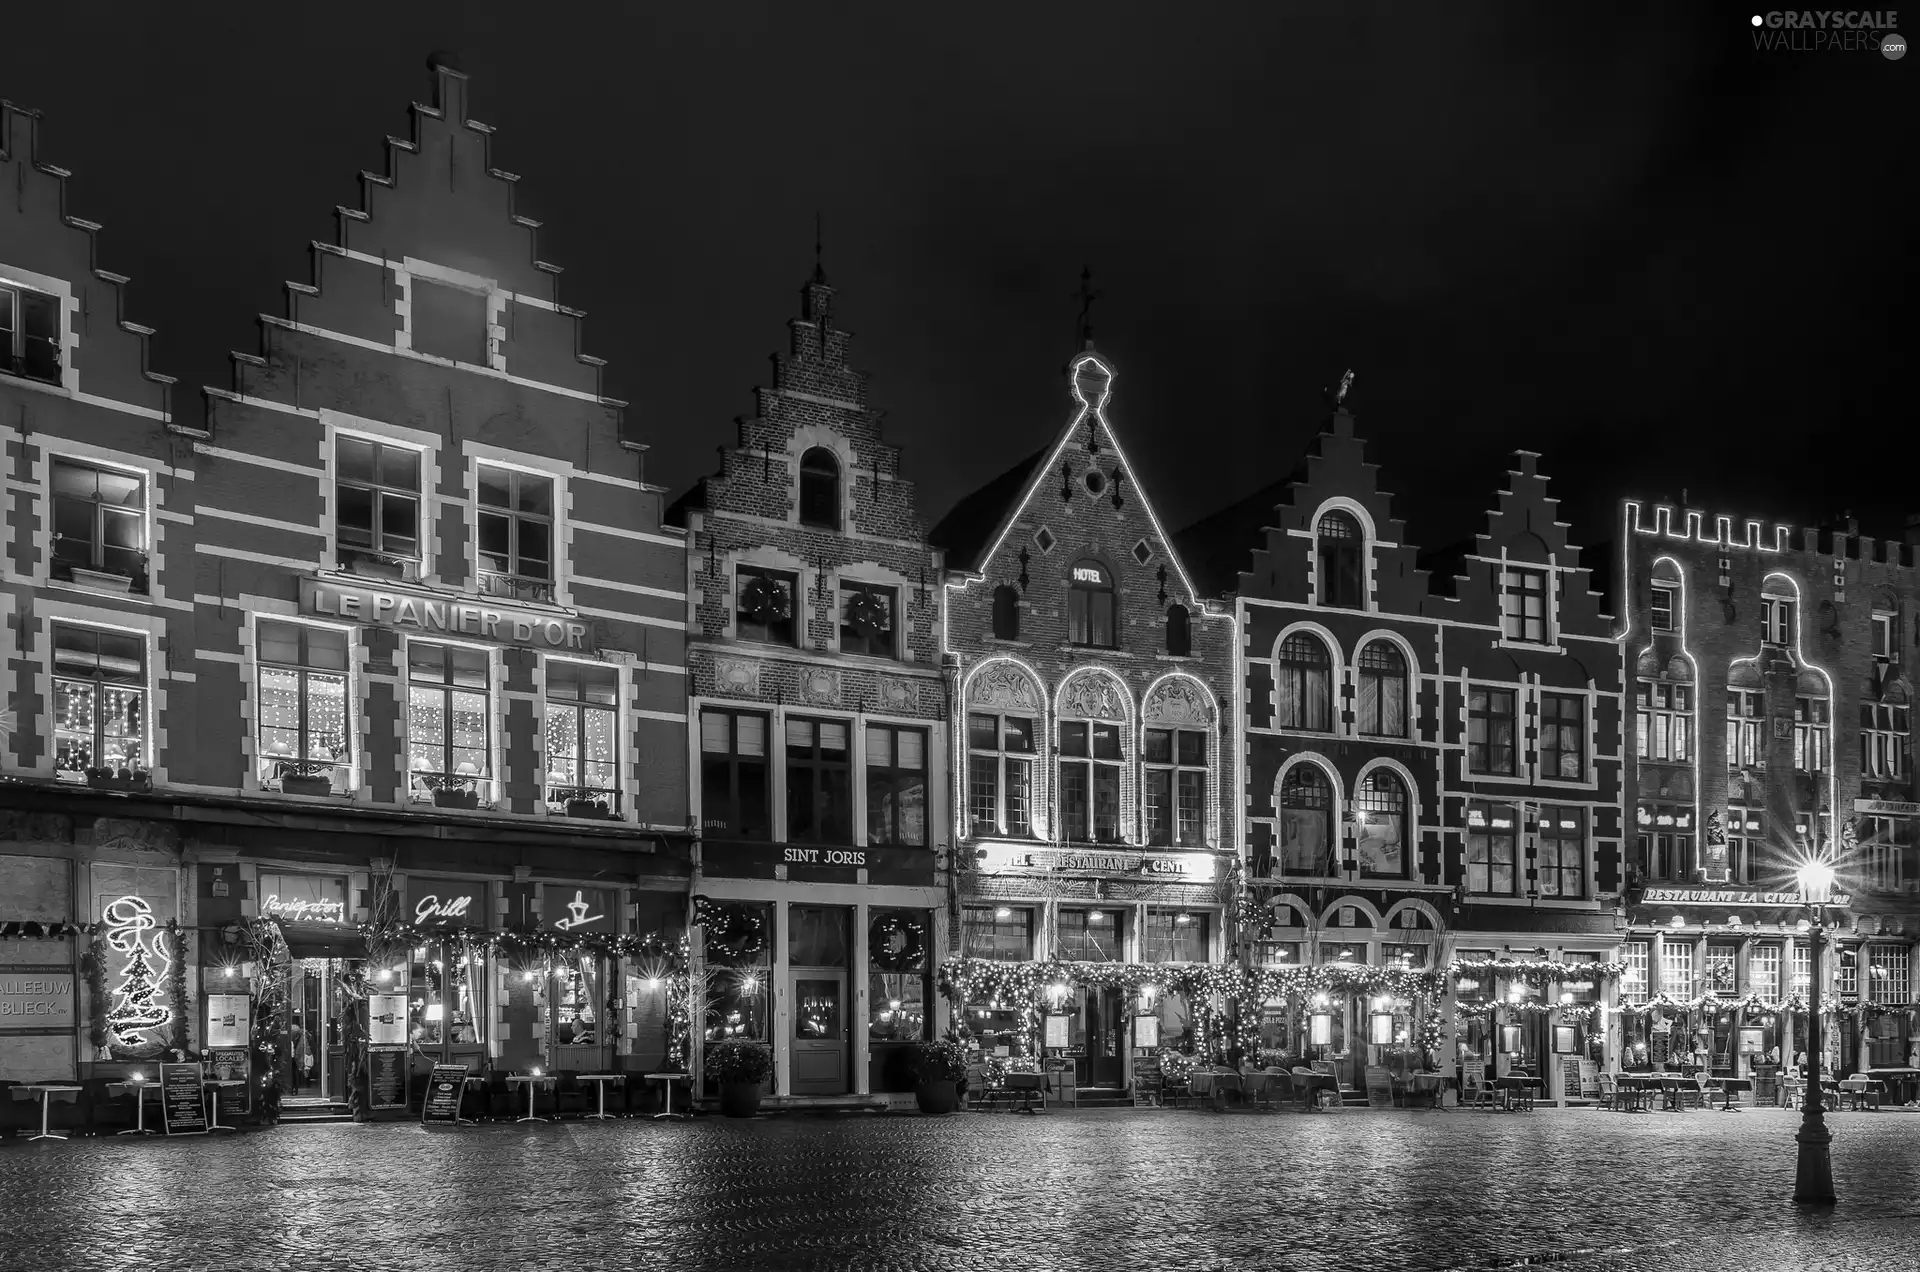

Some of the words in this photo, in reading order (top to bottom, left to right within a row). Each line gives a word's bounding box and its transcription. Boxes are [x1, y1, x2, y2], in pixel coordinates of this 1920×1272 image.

[1073, 567, 1102, 583] HOTEL
[315, 590, 360, 616] LE
[372, 591, 501, 637] PANIER
[513, 617, 586, 649] D'OR
[784, 848, 819, 862] SINT
[824, 850, 866, 865] JORIS
[1053, 856, 1129, 870] RESTAURANT
[1645, 889, 1736, 902] RESTAURANT
[1738, 891, 1757, 903] LA
[414, 894, 472, 925] Grill
[1, 1001, 57, 1016] BLIECK
